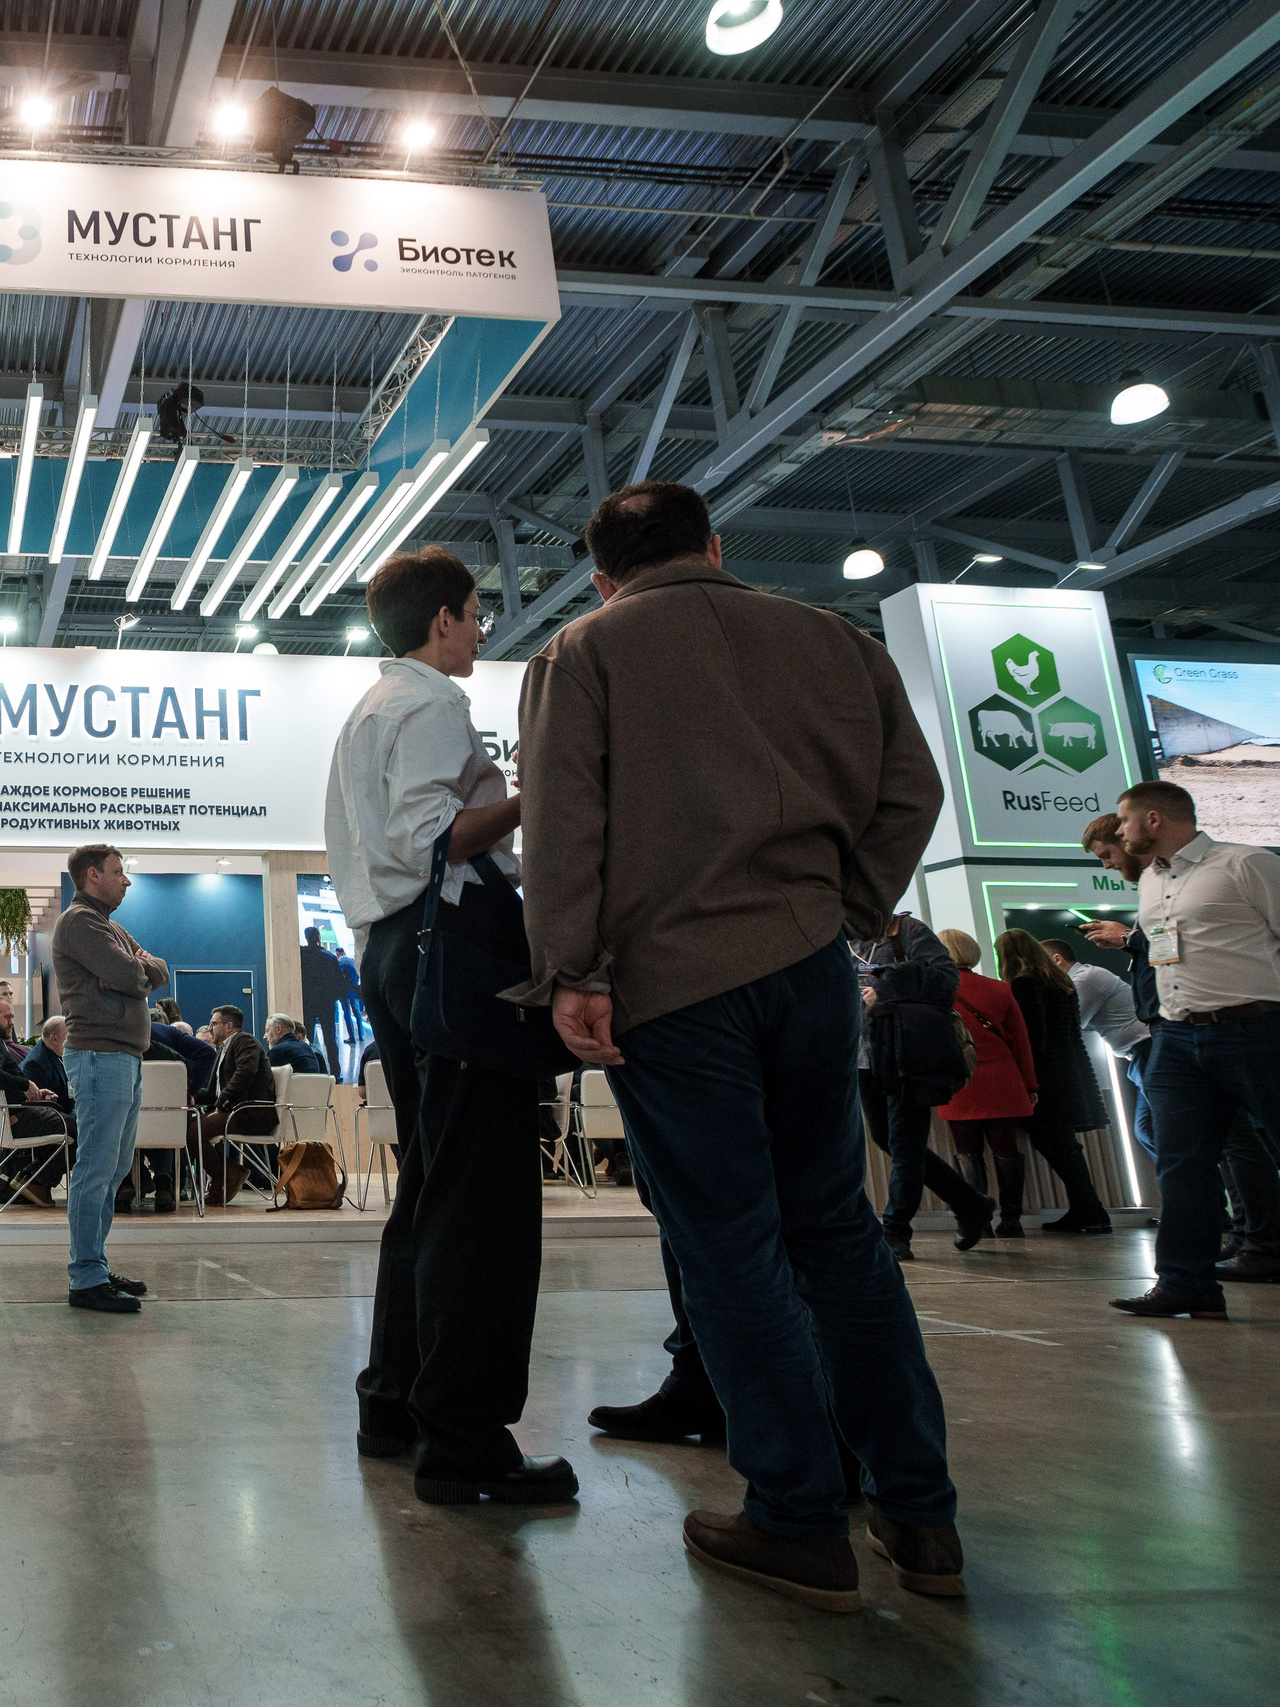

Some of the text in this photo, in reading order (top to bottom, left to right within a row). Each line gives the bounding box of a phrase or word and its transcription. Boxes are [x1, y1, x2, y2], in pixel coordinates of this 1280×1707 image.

[66, 209, 262, 252] МУСТАНГ
[67, 252, 236, 269] ТЕХНОЛОГИИ КОРМЛЕНИЯ
[397, 237, 517, 269] Биотек
[400, 266, 517, 281] ЭКОКОНТРОЛЬ ПАТОГЕНОВ
[1173, 667, 1239, 679] Green Grass
[116, 753, 225, 768] КОРМЛЕНИЯ
[52, 786, 128, 797] КОРМОВОЕ
[130, 788, 191, 799] РЕШЕНИЕ
[1003, 789, 1100, 813] RusFeed
[100, 804, 186, 815] РАСКРЫВАЕТ
[189, 805, 267, 818] ПОТЕНЦИАЛ
[103, 820, 180, 831] ЖИВОТНЫХ
[1092, 875, 1125, 891] Мы
